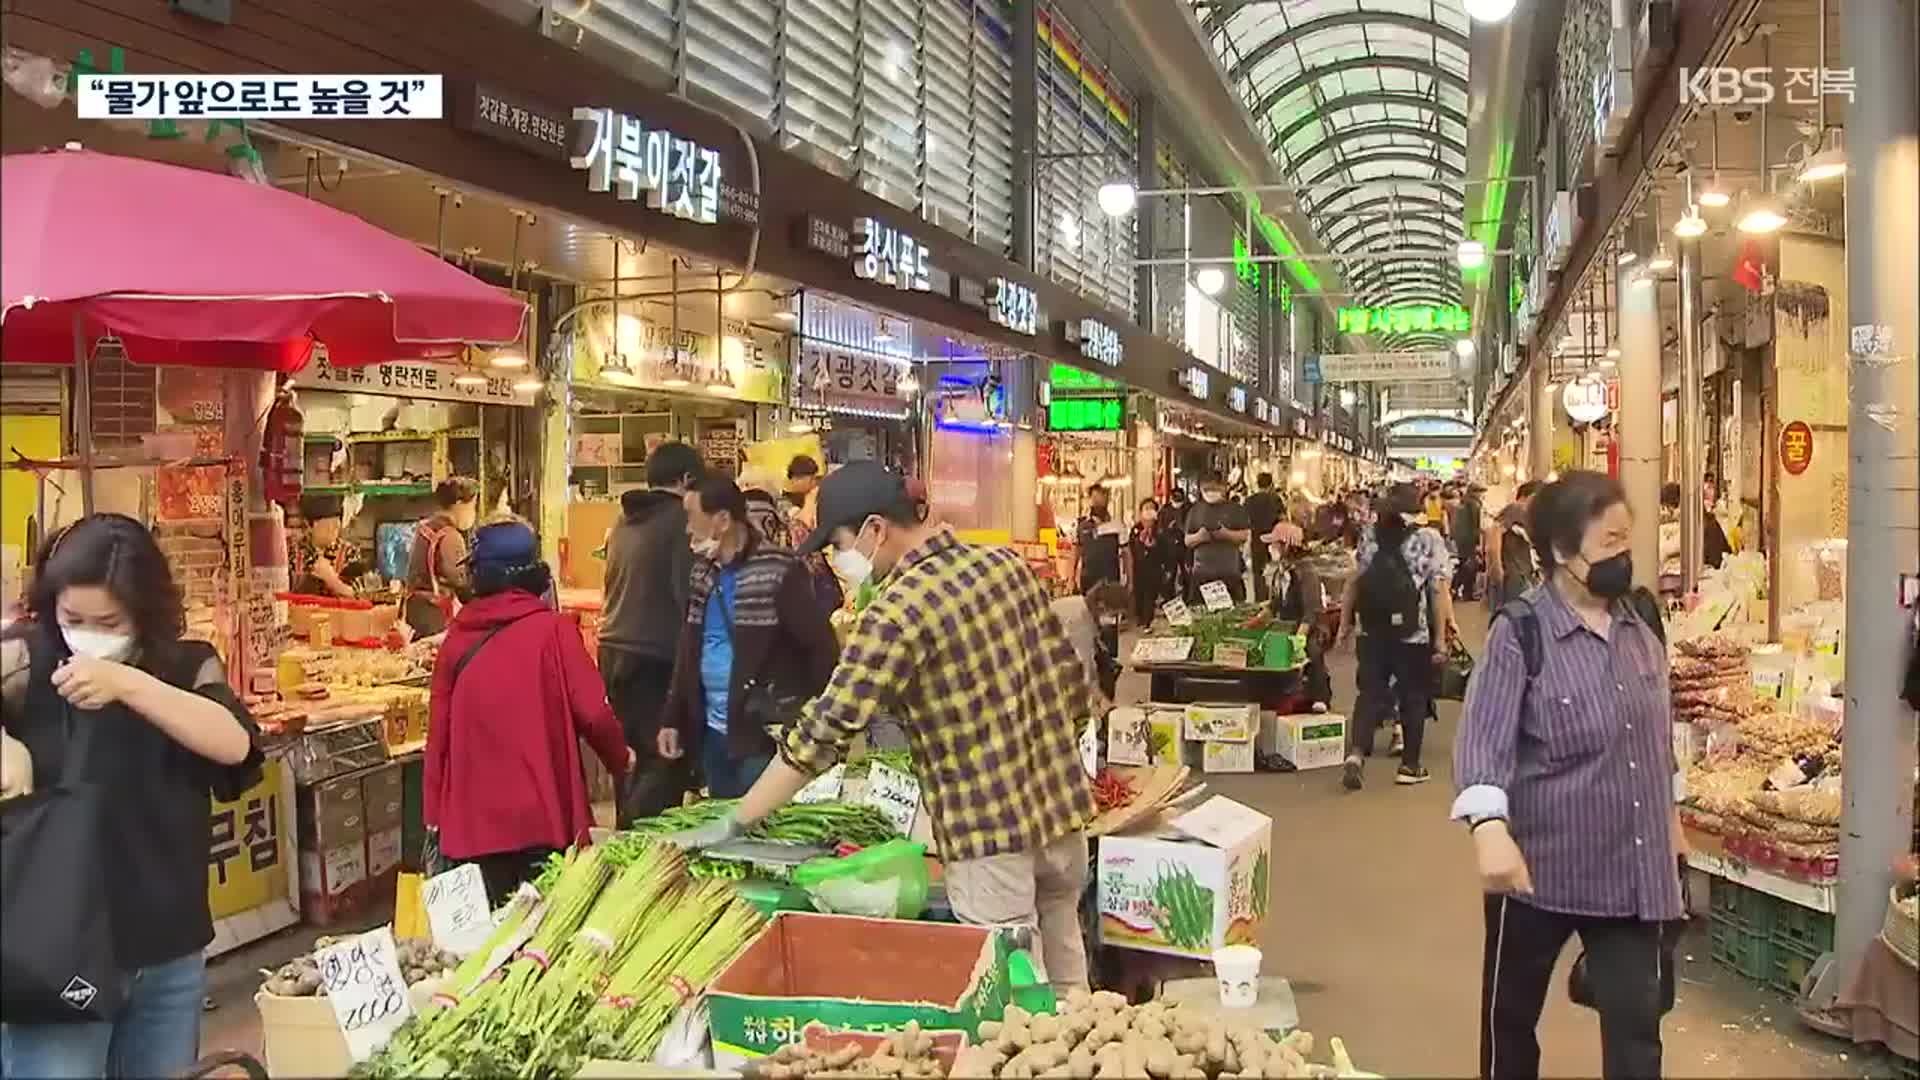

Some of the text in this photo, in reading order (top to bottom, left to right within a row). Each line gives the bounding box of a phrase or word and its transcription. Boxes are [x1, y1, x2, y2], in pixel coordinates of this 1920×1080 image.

[570, 107, 721, 223] 거북이젓갈
[854, 216, 931, 290] 창신푸드
[207, 795, 278, 884] 무침
